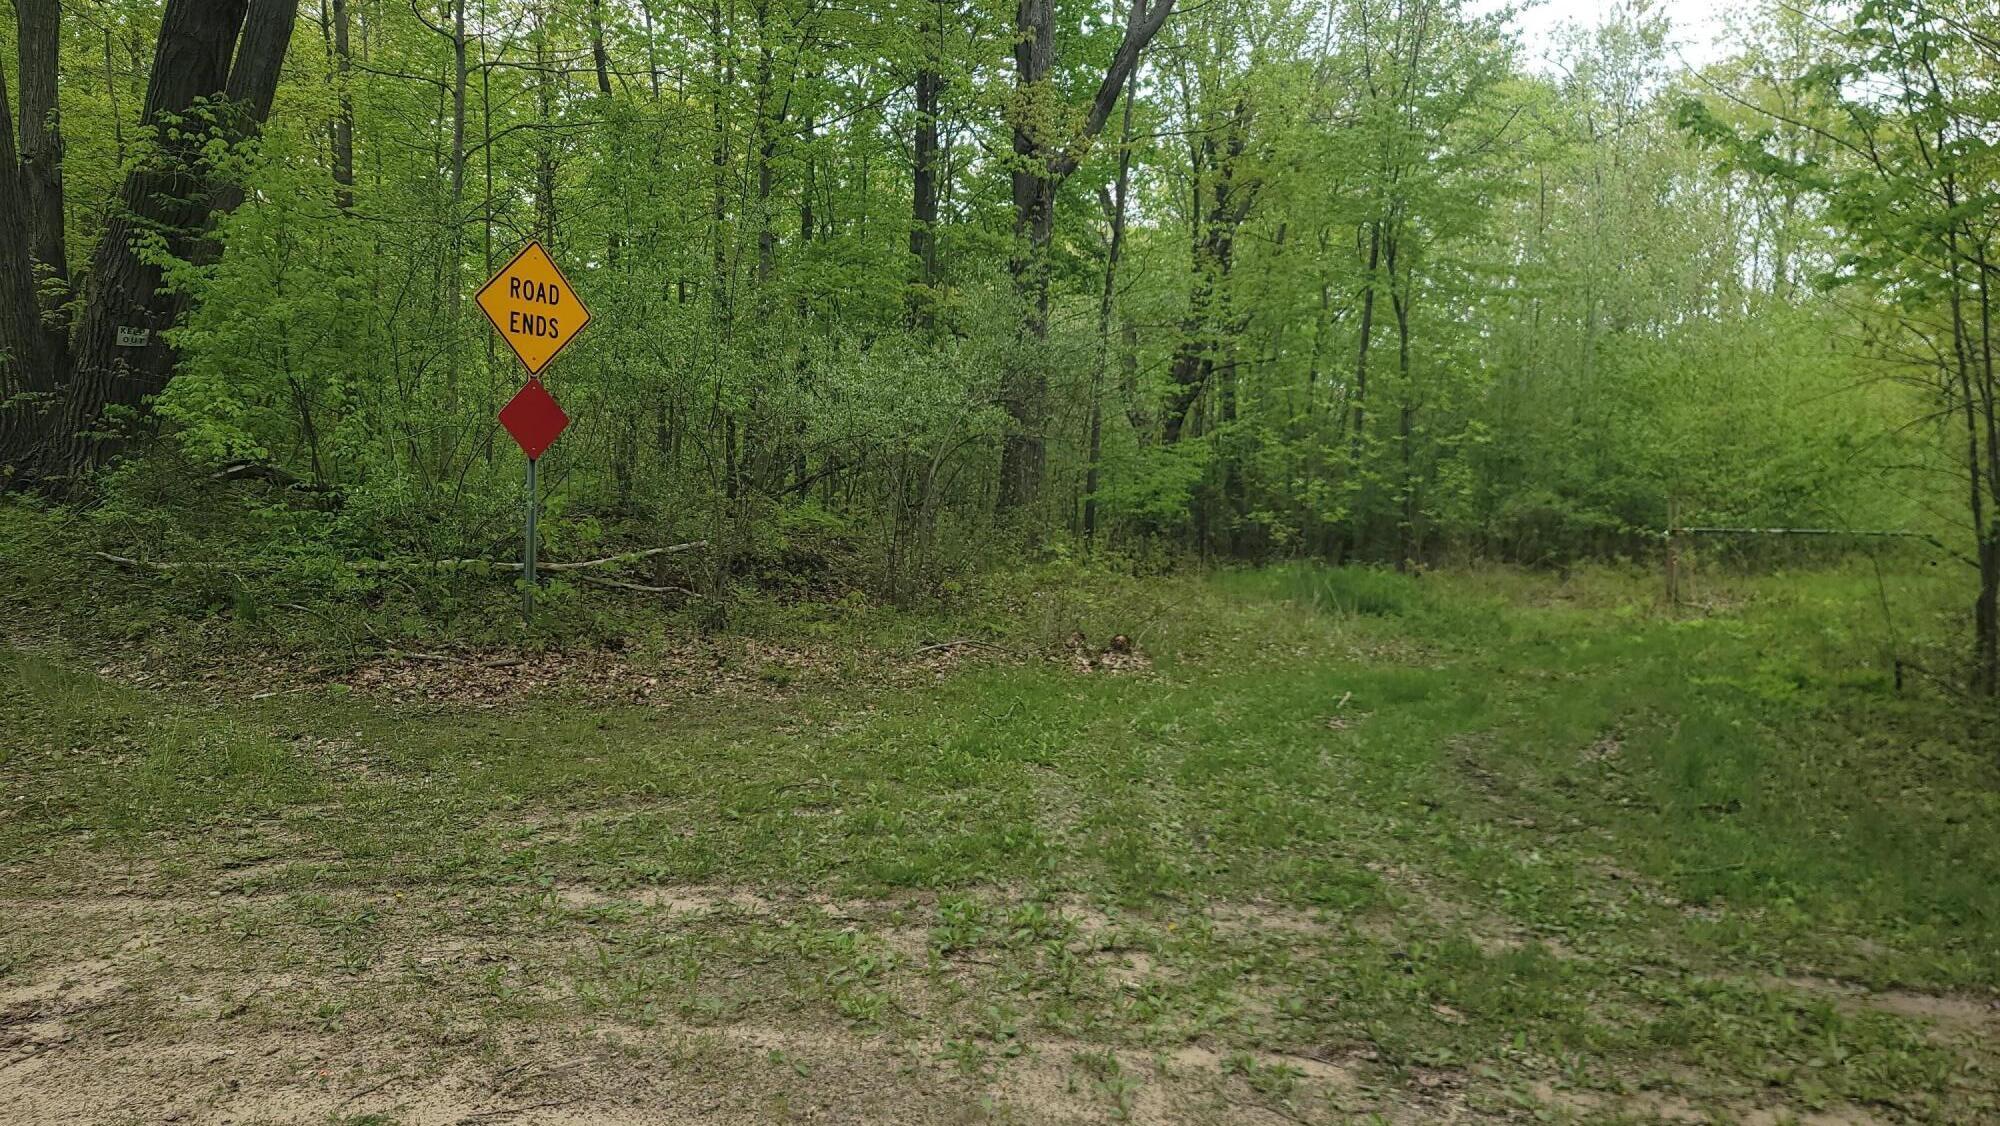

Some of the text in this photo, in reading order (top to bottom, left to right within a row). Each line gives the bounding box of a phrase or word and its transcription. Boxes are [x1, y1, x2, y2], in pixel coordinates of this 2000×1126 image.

[510, 276, 559, 305] ROAD
[510, 311, 558, 339] ENDS
[123, 336, 145, 344] OUT
